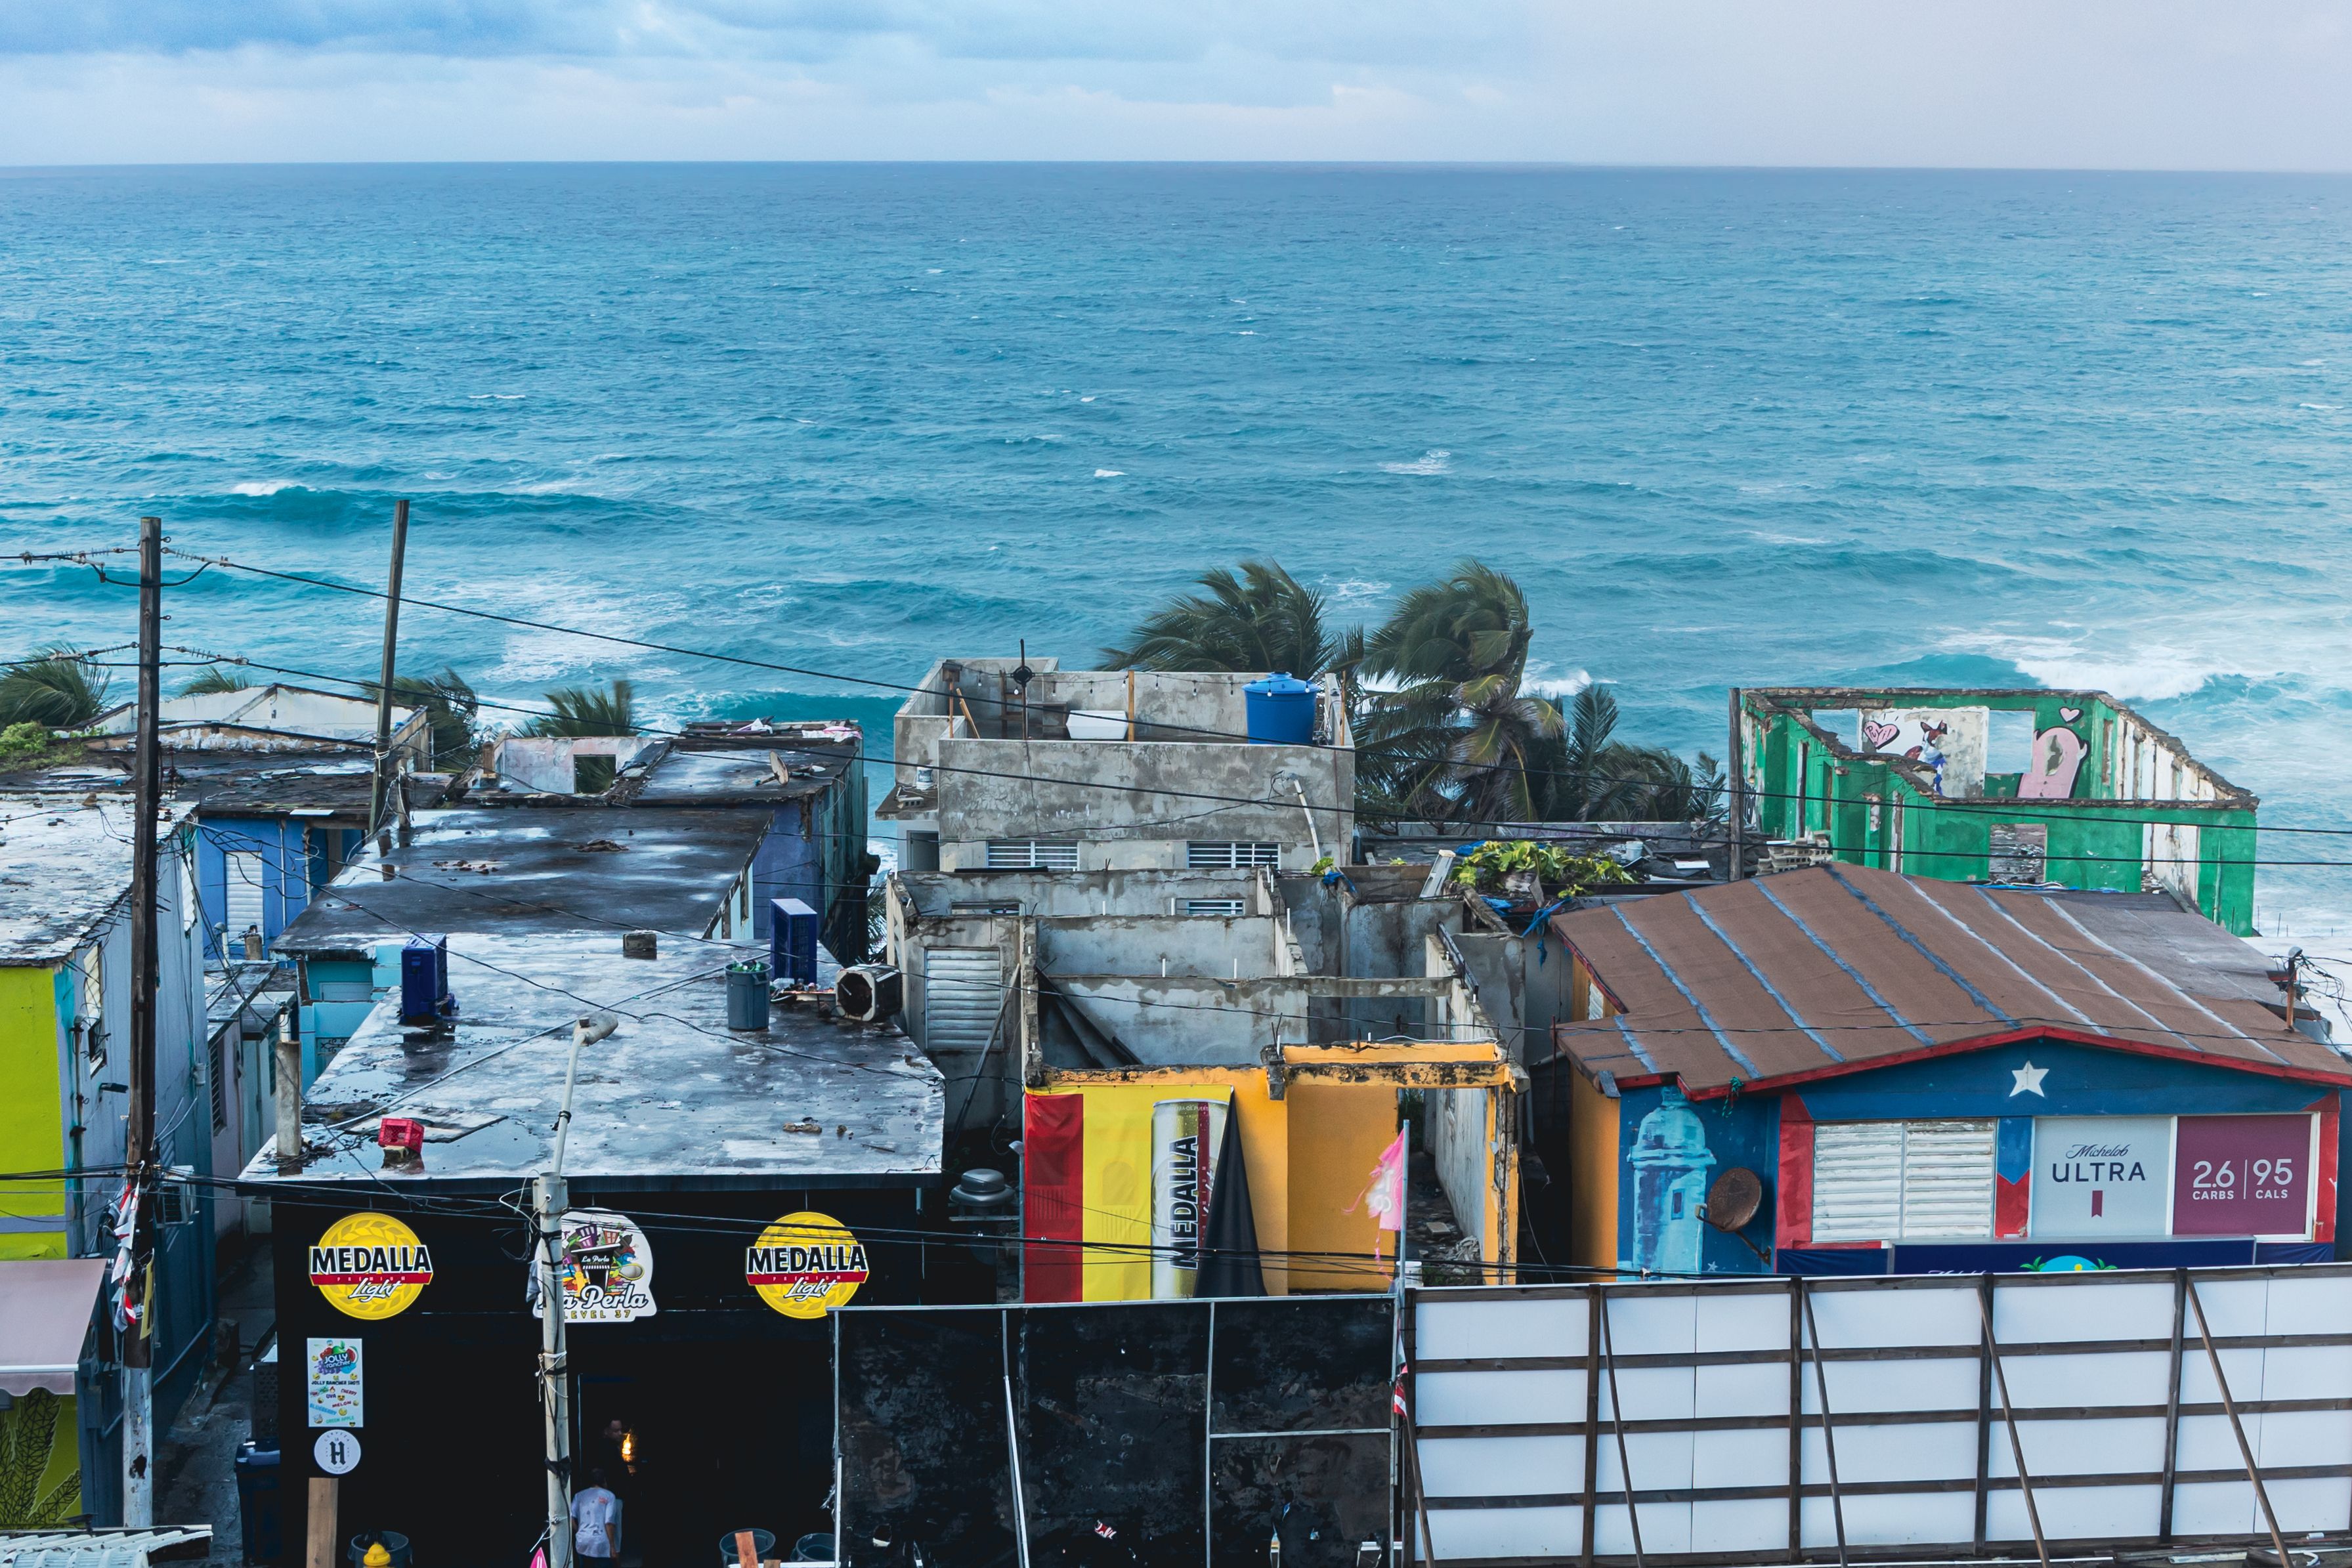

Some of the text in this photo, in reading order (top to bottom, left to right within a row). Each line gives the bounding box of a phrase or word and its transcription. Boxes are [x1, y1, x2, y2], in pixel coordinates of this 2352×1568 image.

[2066, 1144, 2131, 1159] Michelob
[2052, 1162, 2146, 1183] ULTRA
[2193, 1158, 2293, 1188] 2.6 95
[1169, 1135, 1198, 1269] MEDALLA
[2192, 1189, 2288, 1200] CARBS CALS
[310, 1245, 433, 1274] MEDALLA
[747, 1244, 868, 1274] MEDALLA
[348, 1277, 403, 1303] Light
[580, 1284, 649, 1310] Perla
[783, 1277, 837, 1302] Light
[324, 1353, 347, 1364] JOLLY
[330, 1441, 346, 1465] H
